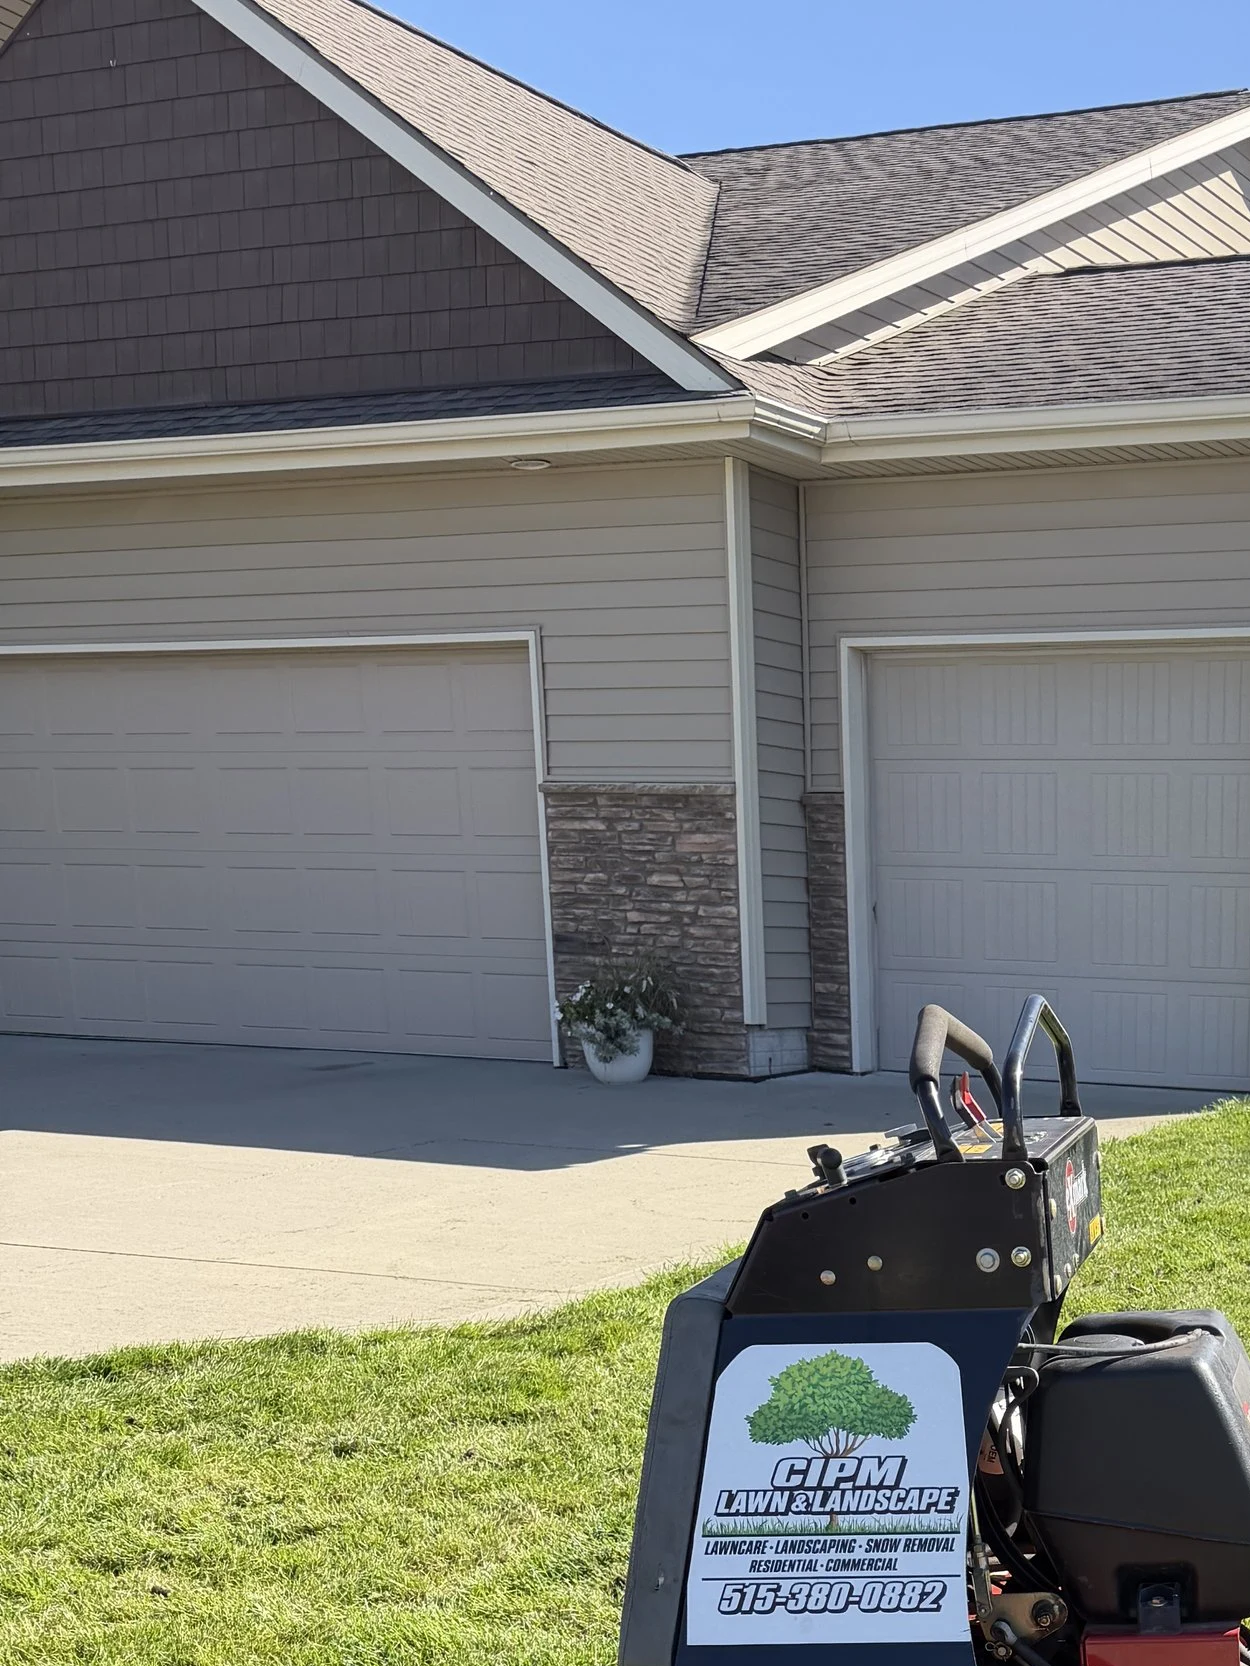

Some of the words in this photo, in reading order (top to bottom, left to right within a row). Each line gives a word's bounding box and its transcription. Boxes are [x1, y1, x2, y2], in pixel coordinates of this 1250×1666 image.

[771, 1456, 908, 1490] CIPM
[704, 1540, 769, 1555] LAWNCARE
[774, 1538, 857, 1554] LANDSCAPING
[865, 1538, 902, 1553] SNOW
[902, 1537, 956, 1553] REMOVAL
[749, 1558, 818, 1573] RESIDENTIAL
[825, 1557, 898, 1572] COMMERCIAL
[718, 1580, 947, 1616] 515-380-0882
